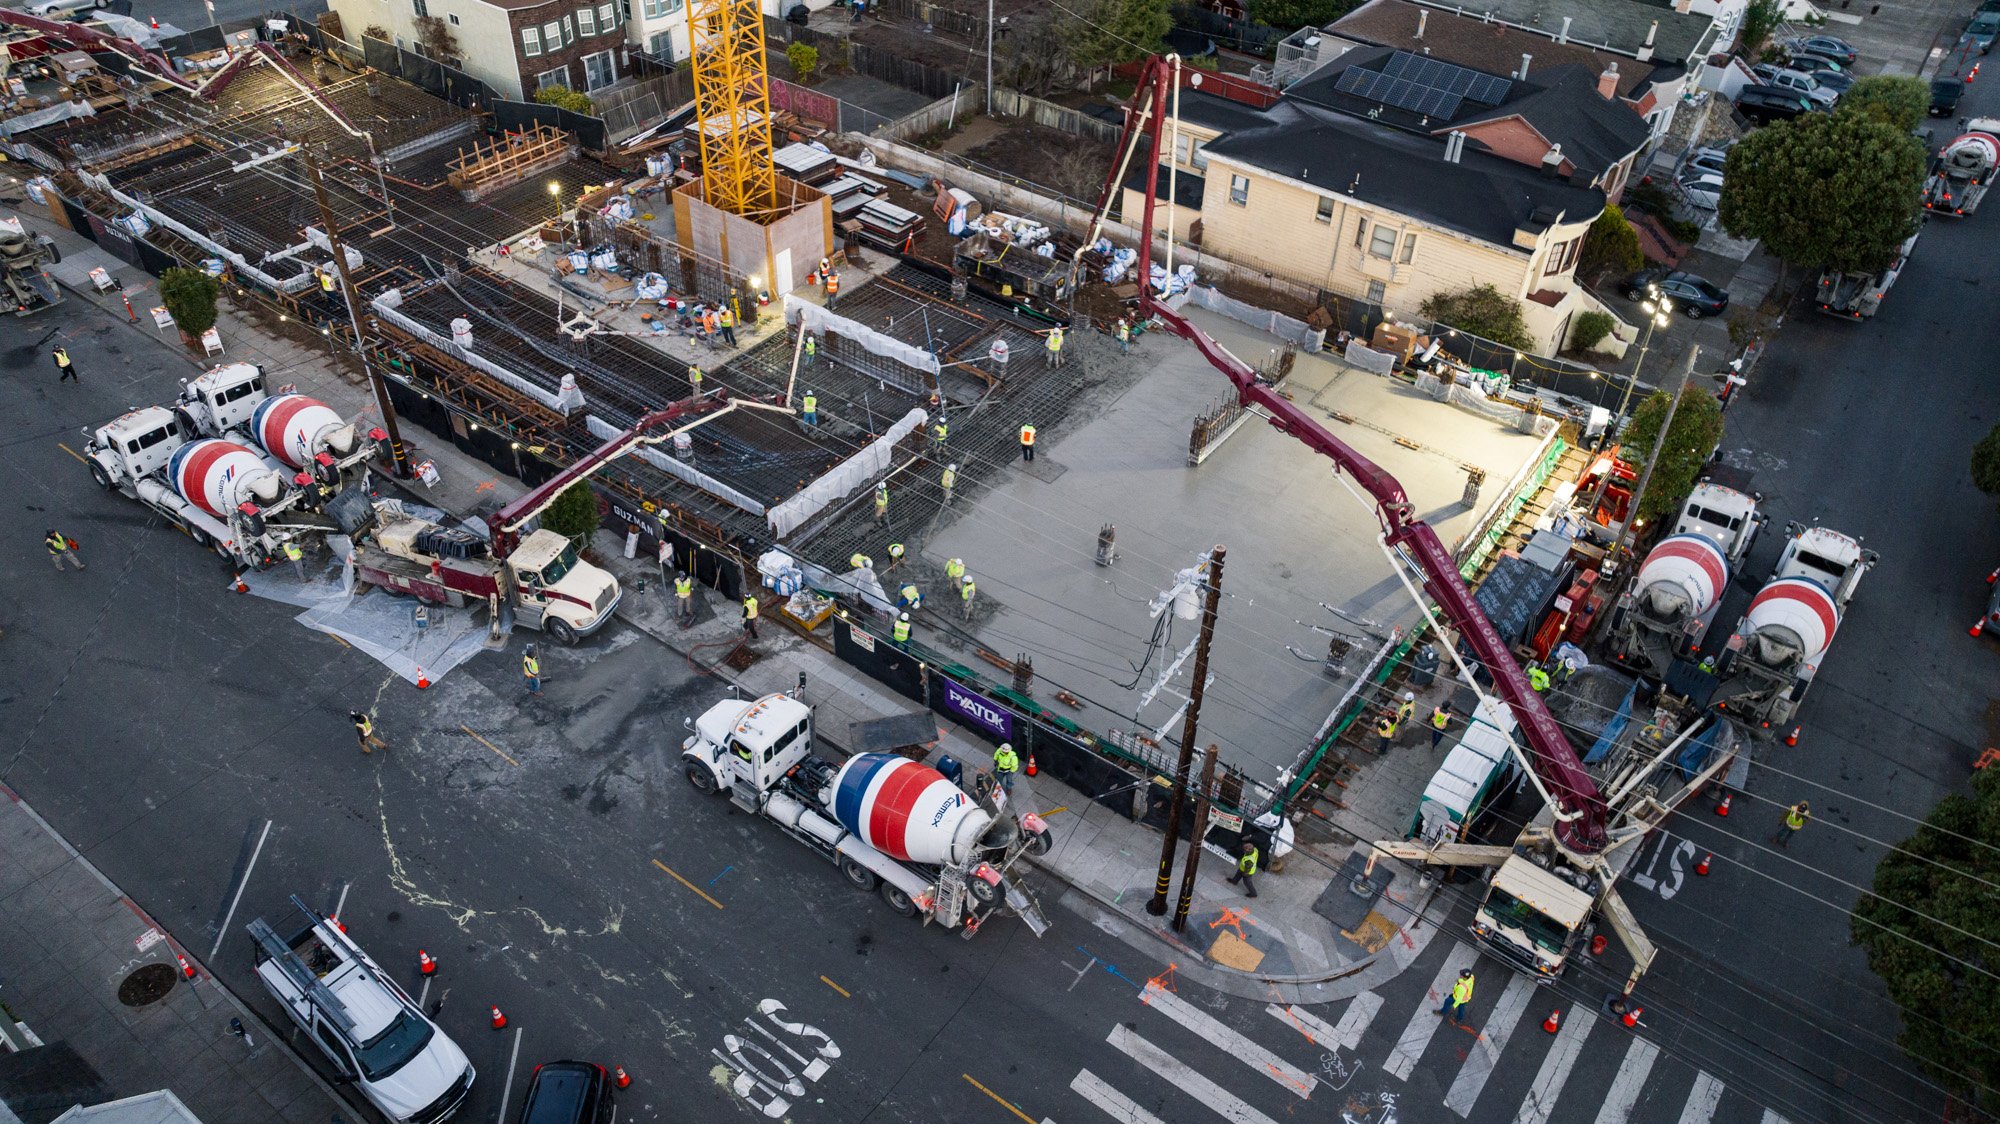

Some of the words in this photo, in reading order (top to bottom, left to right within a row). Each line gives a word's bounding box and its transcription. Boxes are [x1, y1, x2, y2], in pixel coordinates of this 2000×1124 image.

[613, 505, 654, 536] GUZMAN
[949, 688, 1005, 731] PYATOK
[931, 796, 956, 828] CEMEX
[711, 998, 841, 1119] STOP
